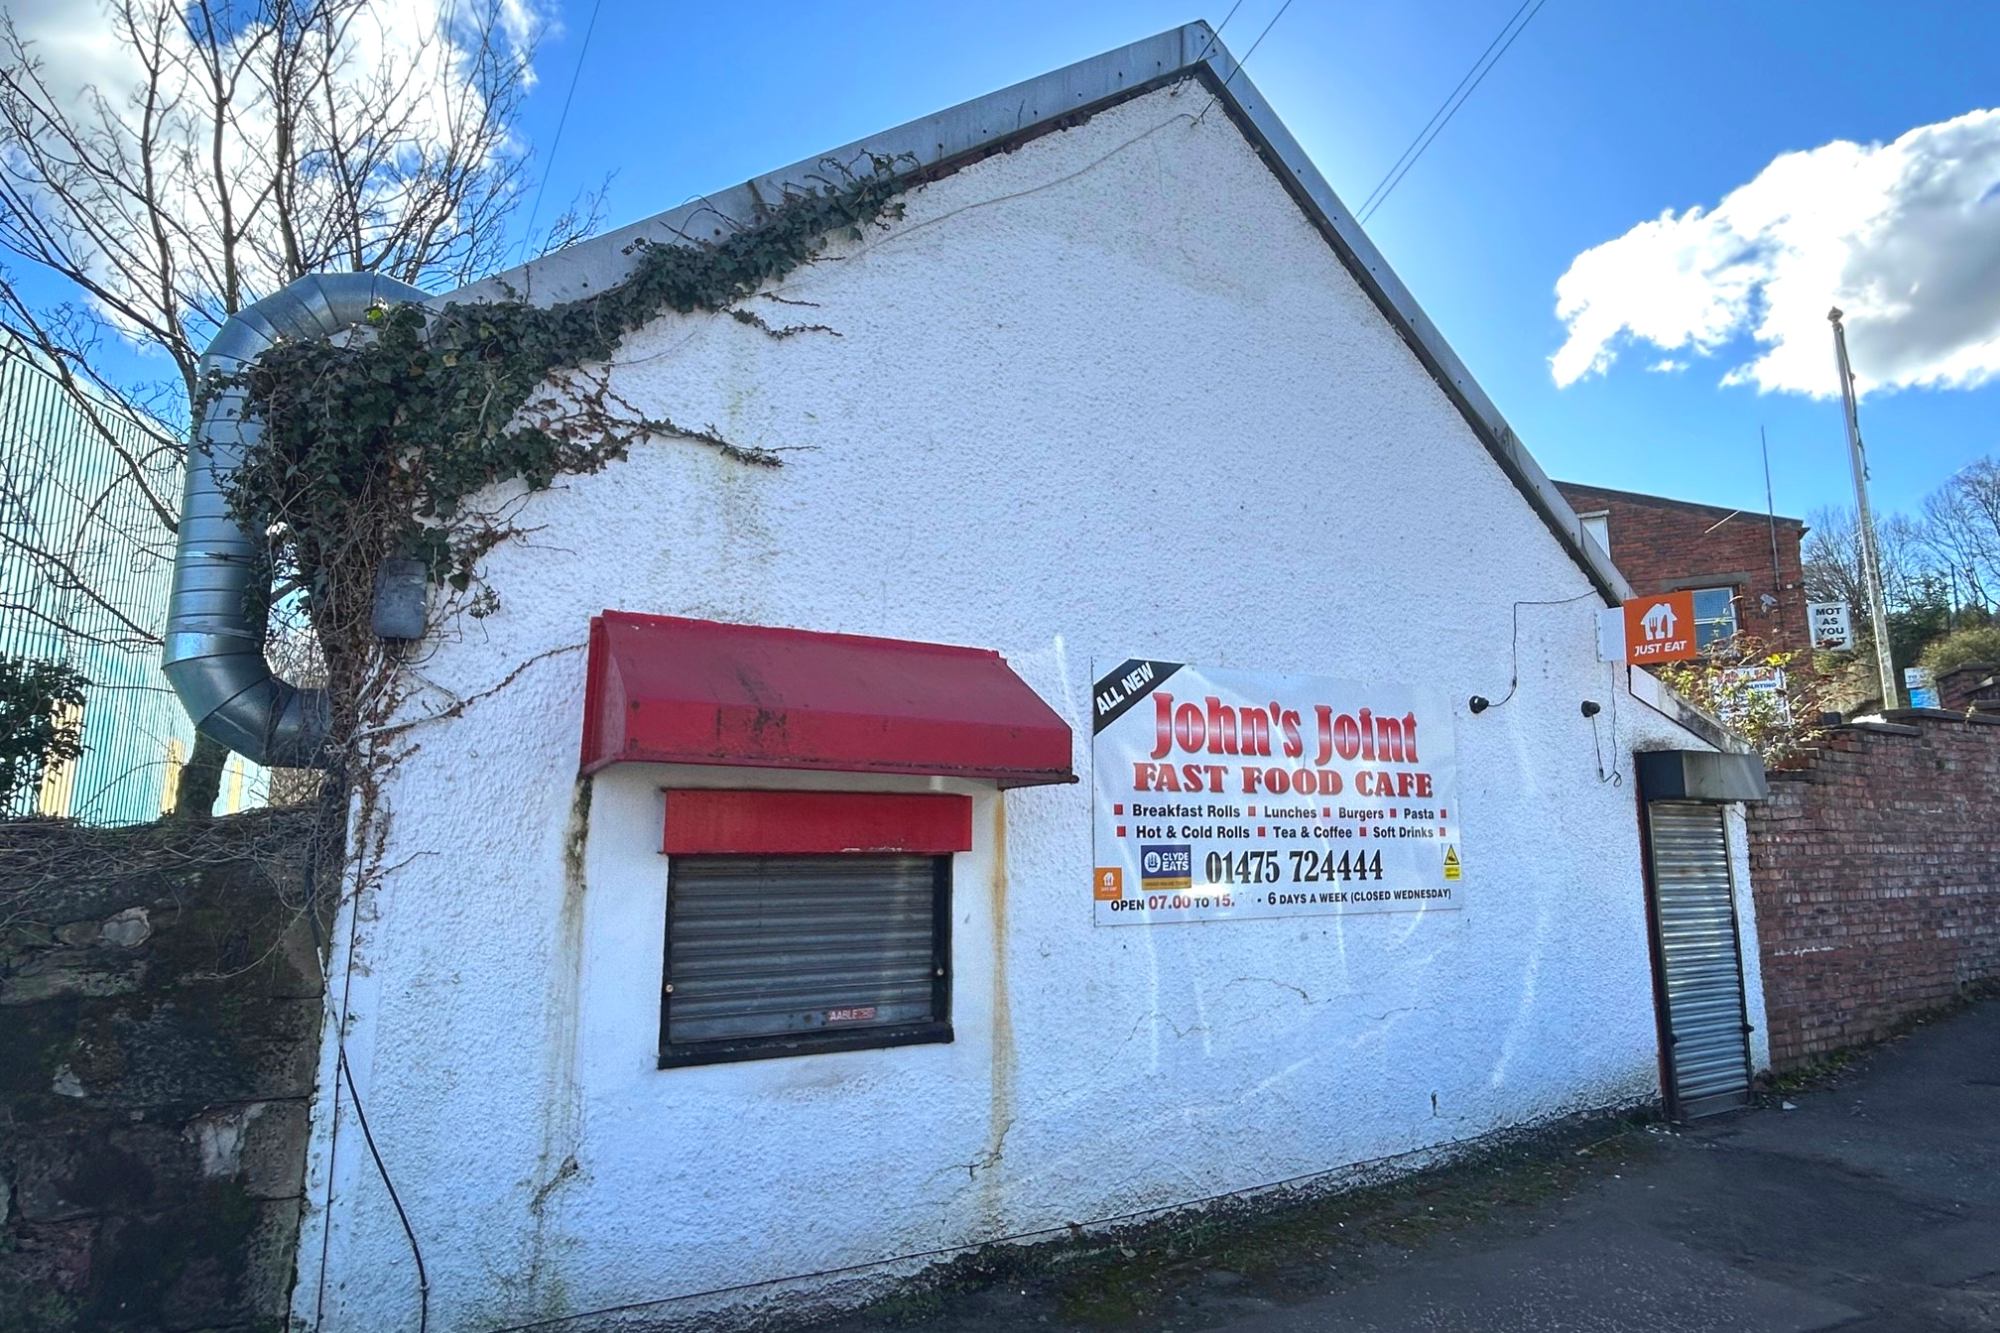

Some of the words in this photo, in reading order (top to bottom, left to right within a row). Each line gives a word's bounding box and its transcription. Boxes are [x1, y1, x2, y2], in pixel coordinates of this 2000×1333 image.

[1816, 607, 1841, 616] MOT
[1822, 617, 1838, 625] AS
[1818, 627, 1844, 635] YOU
[1634, 643, 1662, 657] JUST
[1664, 640, 1687, 652] EAT
[1096, 686, 1124, 715] ALL
[1121, 661, 1154, 695] NEW
[1150, 691, 1303, 759] John's
[1314, 704, 1419, 766] Joint
[1133, 762, 1228, 793] FAST
[1241, 766, 1343, 796] FOOD
[1354, 770, 1434, 798] CAFE
[1132, 803, 1203, 817] Breakfast
[1207, 805, 1240, 818] Rolls
[1264, 805, 1317, 818] Lunches
[1339, 807, 1385, 821] Burgers
[1403, 808, 1434, 819] Pasta
[1136, 825, 1161, 838] Hot
[1166, 825, 1177, 838] &
[1181, 825, 1212, 838] Cold
[1217, 826, 1250, 838] Rolls
[1273, 826, 1296, 838] Tea
[1300, 826, 1310, 838] &
[1313, 826, 1352, 838] Coffee
[1373, 826, 1395, 838] Soft
[1399, 827, 1434, 838] Drinks
[1162, 852, 1189, 861] CLYDE
[1162, 861, 1189, 871] EATS
[1205, 850, 1280, 884] 01475
[1289, 849, 1383, 882] 724444
[1111, 900, 1145, 911] OPEN
[1149, 896, 1191, 909] 07.00
[1194, 897, 1209, 908] TO
[1214, 893, 1243, 907] 15.
[1268, 892, 1277, 905] 6
[1279, 893, 1307, 905] DAYS
[1309, 893, 1317, 903] A
[1319, 891, 1348, 903] WEEK
[1351, 890, 1391, 904] (CLOSED
[1393, 888, 1451, 900] WEDNESDAY)
